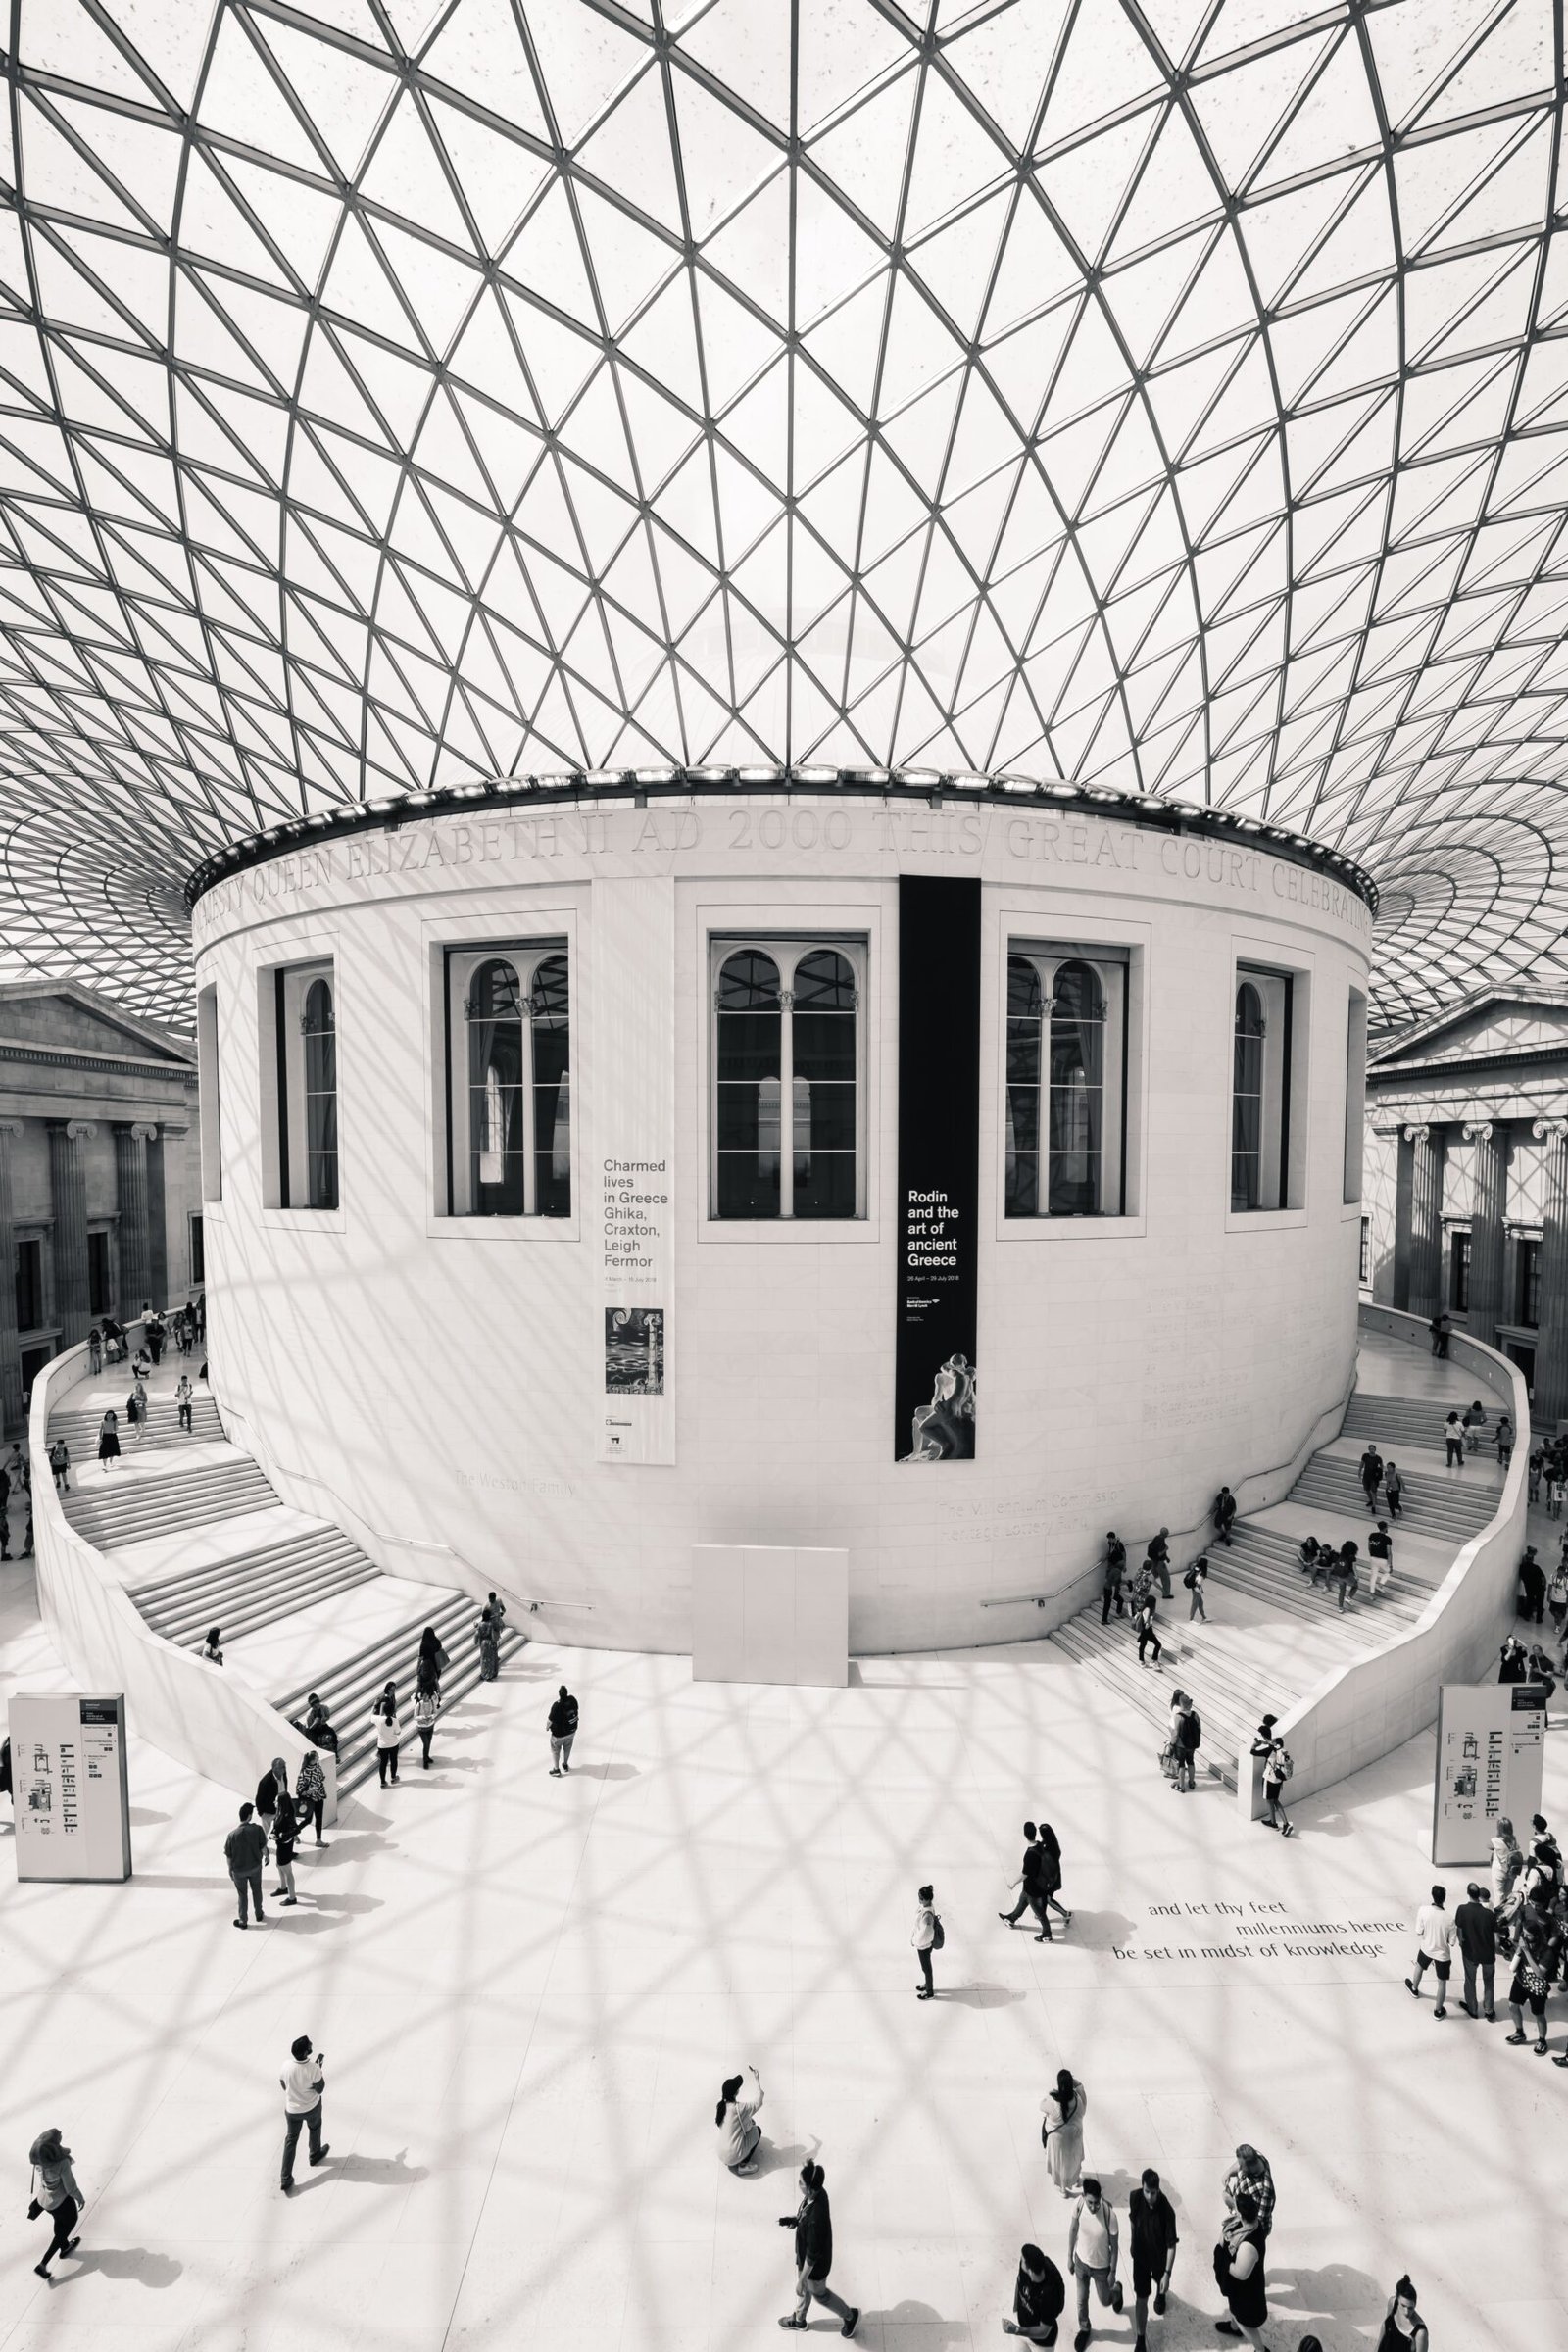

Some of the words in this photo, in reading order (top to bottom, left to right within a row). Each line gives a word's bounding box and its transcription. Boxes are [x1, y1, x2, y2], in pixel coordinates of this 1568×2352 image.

[253, 848, 334, 906] QUEEN
[346, 816, 564, 880] ELIZABETH
[582, 813, 613, 855] II
[632, 810, 702, 852] AD
[728, 809, 852, 850] 2000
[872, 811, 981, 855] THIS
[1005, 819, 1144, 870] GREAT
[1160, 838, 1261, 891] COURT
[604, 1159, 665, 1172] Charmed
[604, 1176, 634, 1188] lives
[604, 1192, 615, 1203] in
[619, 1192, 668, 1204] Greece
[908, 1190, 948, 1203] Rodin
[604, 1207, 647, 1221] Ghika,
[907, 1206, 933, 1219] and
[937, 1206, 959, 1219] the
[604, 1223, 660, 1238] Craxton,
[907, 1222, 926, 1235] art
[930, 1222, 944, 1235] of
[605, 1239, 640, 1253] Leigh
[907, 1238, 957, 1250] ancient
[605, 1254, 653, 1267] Fermor
[907, 1253, 957, 1266] Greece
[1149, 1903, 1182, 1916] and
[1185, 1902, 1210, 1915] let
[1214, 1902, 1246, 1919] thy
[1250, 1900, 1289, 1914] feet
[1236, 1921, 1348, 1936] millenniums
[1349, 1919, 1408, 1934] hence
[1112, 1946, 1139, 1960] be
[1144, 1946, 1174, 1960] set
[1178, 1947, 1197, 1959] in
[1201, 1943, 1254, 1959] midst
[1259, 1943, 1280, 1958] of
[1284, 1941, 1387, 1958] knowledge
